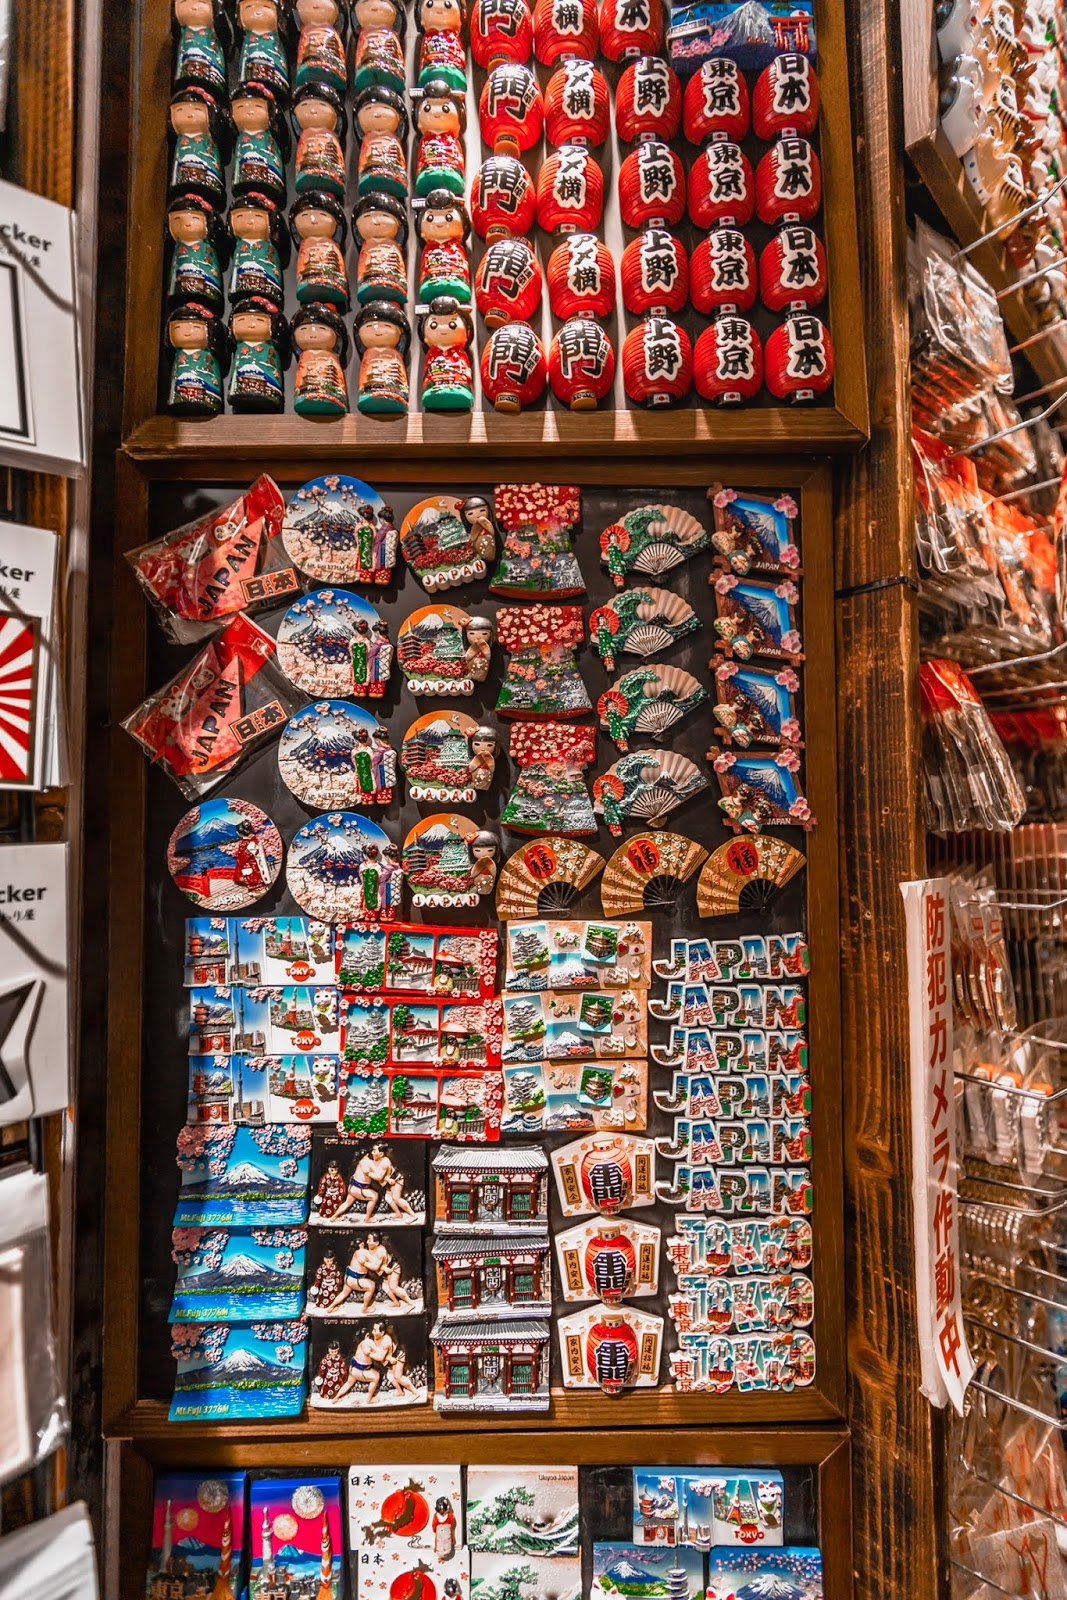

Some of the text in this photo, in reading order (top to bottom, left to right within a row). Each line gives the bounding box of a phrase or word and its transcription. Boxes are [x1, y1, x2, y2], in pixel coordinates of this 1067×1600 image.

[555, 3, 579, 31] 横
[637, 57, 668, 113] 上野
[709, 58, 737, 113] 東京
[777, 56, 807, 109] 日本
[642, 143, 673, 199] 上野
[713, 145, 743, 198] 東京
[779, 140, 811, 194] 日本
[573, 236, 598, 293] アメ横
[645, 231, 676, 287] 上野
[716, 231, 745, 286] 東京
[787, 229, 818, 283] 日本
[647, 320, 679, 376] 上野
[721, 320, 750, 376] 東京
[795, 319, 823, 374] 日本
[198, 534, 257, 615] JAPAN
[424, 560, 485, 586] JAPAN
[756, 561, 780, 570] JAPAN
[246, 572, 296, 599] 日本
[758, 647, 781, 655] JAPAN
[409, 680, 473, 692] JAPAN
[192, 679, 237, 767] JAPAN
[236, 706, 285, 739] 日本
[757, 734, 781, 743] JAPAN
[411, 787, 475, 801] JAPAN
[529, 847, 554, 877] 福
[631, 843, 657, 873] 福
[731, 846, 755, 872] 福
[213, 893, 244, 907] JAPAN
[413, 894, 477, 907] JAPAN
[285, 967, 316, 977] TOKYO
[652, 932, 808, 983] JAPAN
[648, 981, 805, 1029] JAPAN
[290, 1037, 322, 1046] TOKYO
[650, 1025, 808, 1074] JAPAN
[289, 1106, 321, 1115] TOKYO
[653, 1070, 811, 1120] JAPAN
[566, 1118, 594, 1129] Japan
[925, 895, 963, 1377] 防犯カメラ作動中
[655, 1117, 812, 1166] JAPAN
[564, 1167, 578, 1200] 家内安全
[655, 1164, 813, 1215] JAPAN
[206, 1214, 233, 1222] 3776M
[670, 1243, 690, 1274] 東京
[675, 1214, 813, 1275] TOKYO
[567, 1252, 581, 1287] 家内安全
[202, 1309, 228, 1317] 3776M
[672, 1300, 692, 1332] 東京
[677, 1274, 815, 1333] TOKYO
[569, 1338, 582, 1373] 家内安全
[679, 1332, 816, 1393] TOKYO
[673, 1360, 693, 1391] 東京
[202, 1403, 229, 1414] 3776M
[351, 1475, 375, 1486] 日本
[734, 1530, 765, 1540] TOKYO
[361, 1553, 385, 1565] 日本
